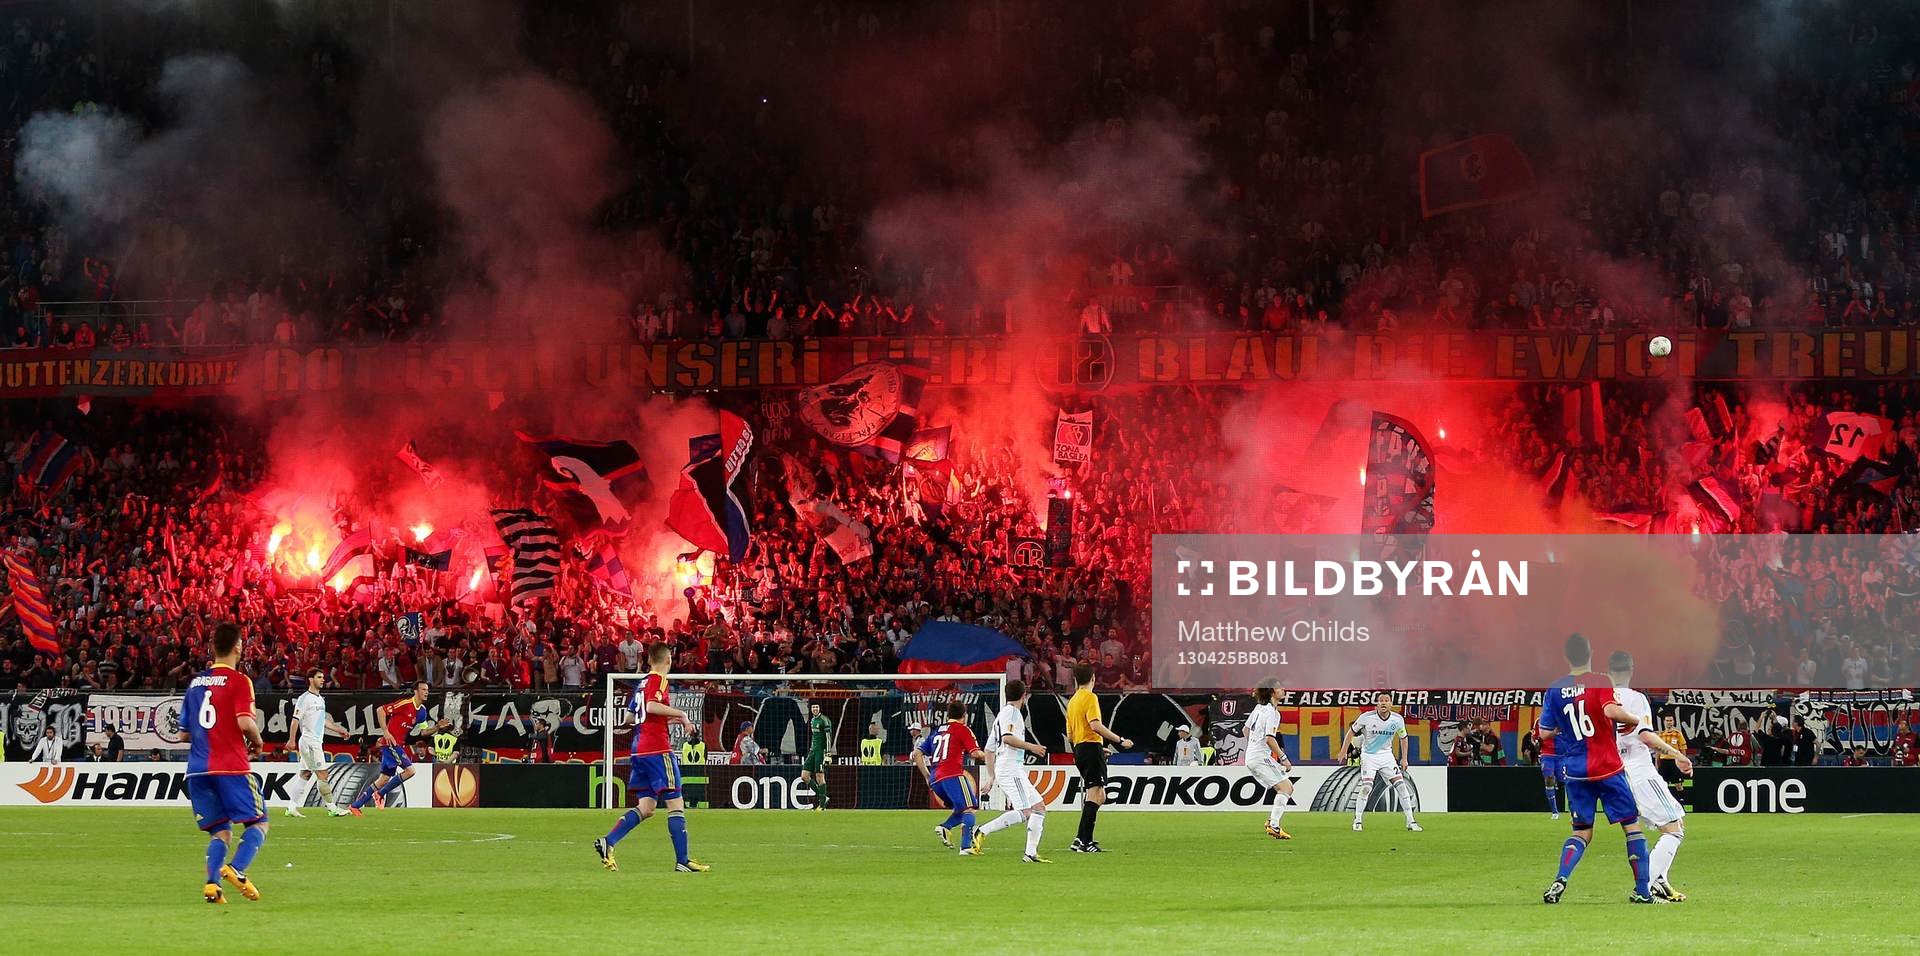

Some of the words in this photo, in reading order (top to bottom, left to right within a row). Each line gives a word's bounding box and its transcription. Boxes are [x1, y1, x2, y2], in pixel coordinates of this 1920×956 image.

[0, 360, 238, 386] UTTENZERKURVE
[199, 690, 216, 728] 6
[1302, 690, 1333, 706] ALS
[1446, 690, 1526, 706] WENIGER
[90, 705, 152, 734] 1997
[1563, 700, 1595, 741] 16
[932, 733, 950, 762] 21
[731, 776, 818, 809] one
[1717, 778, 1807, 814] one
